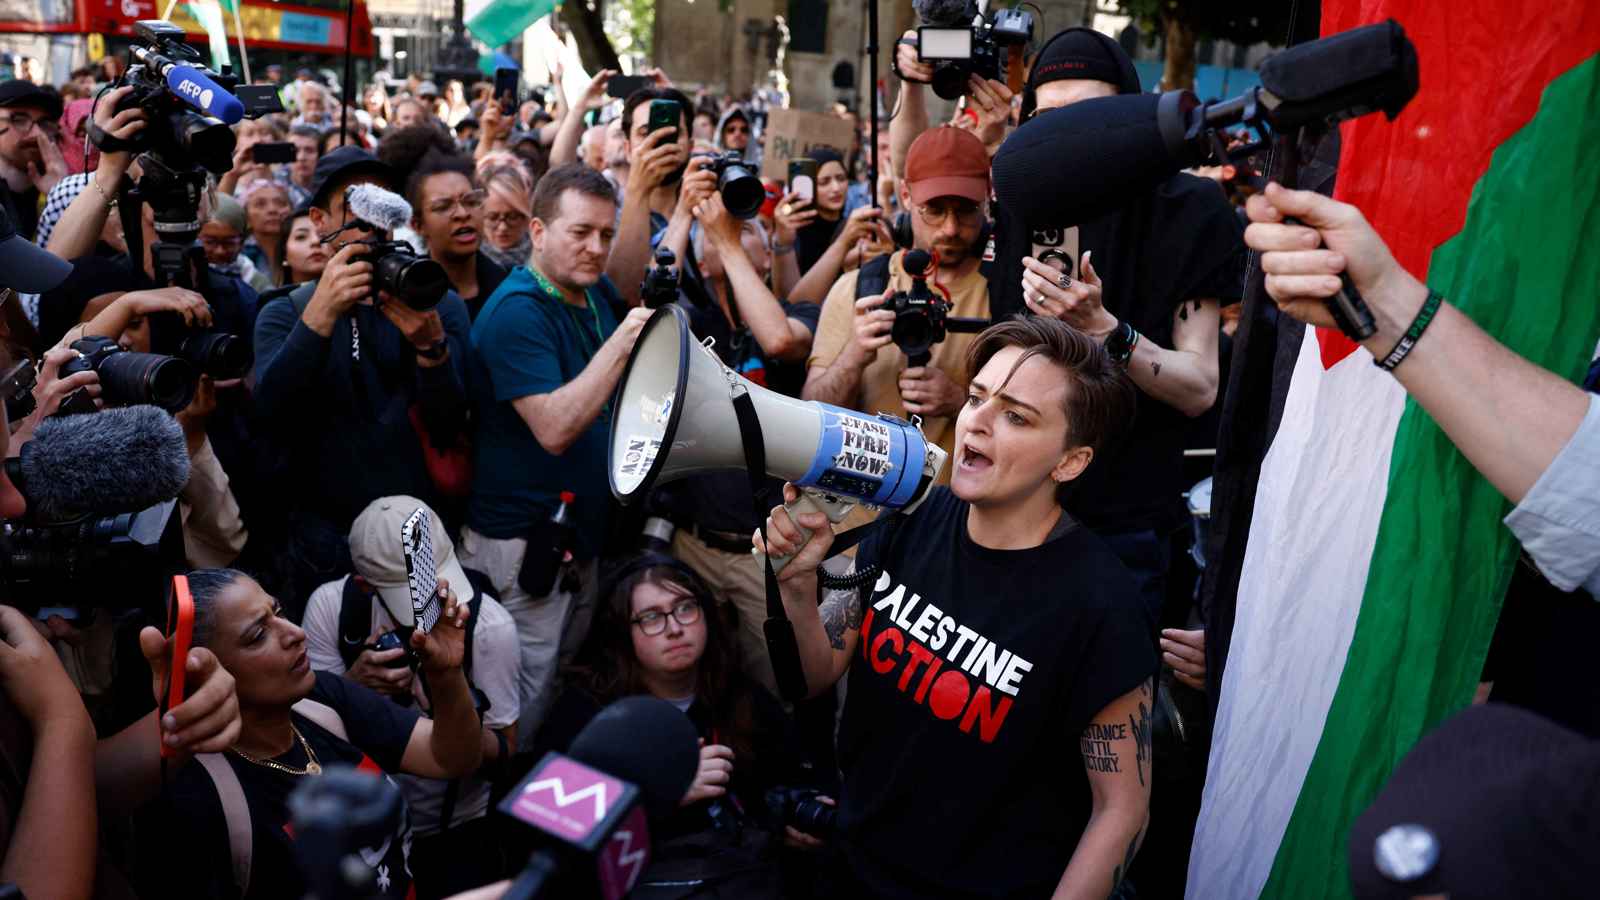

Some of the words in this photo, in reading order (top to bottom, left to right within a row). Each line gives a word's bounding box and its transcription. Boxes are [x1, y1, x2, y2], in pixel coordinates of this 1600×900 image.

[178, 80, 201, 98] AFP
[1384, 336, 1414, 367] FREE
[620, 439, 646, 475] NOW
[844, 430, 889, 456] FIRE
[840, 451, 888, 475] NOW
[860, 607, 1014, 743] ACTION
